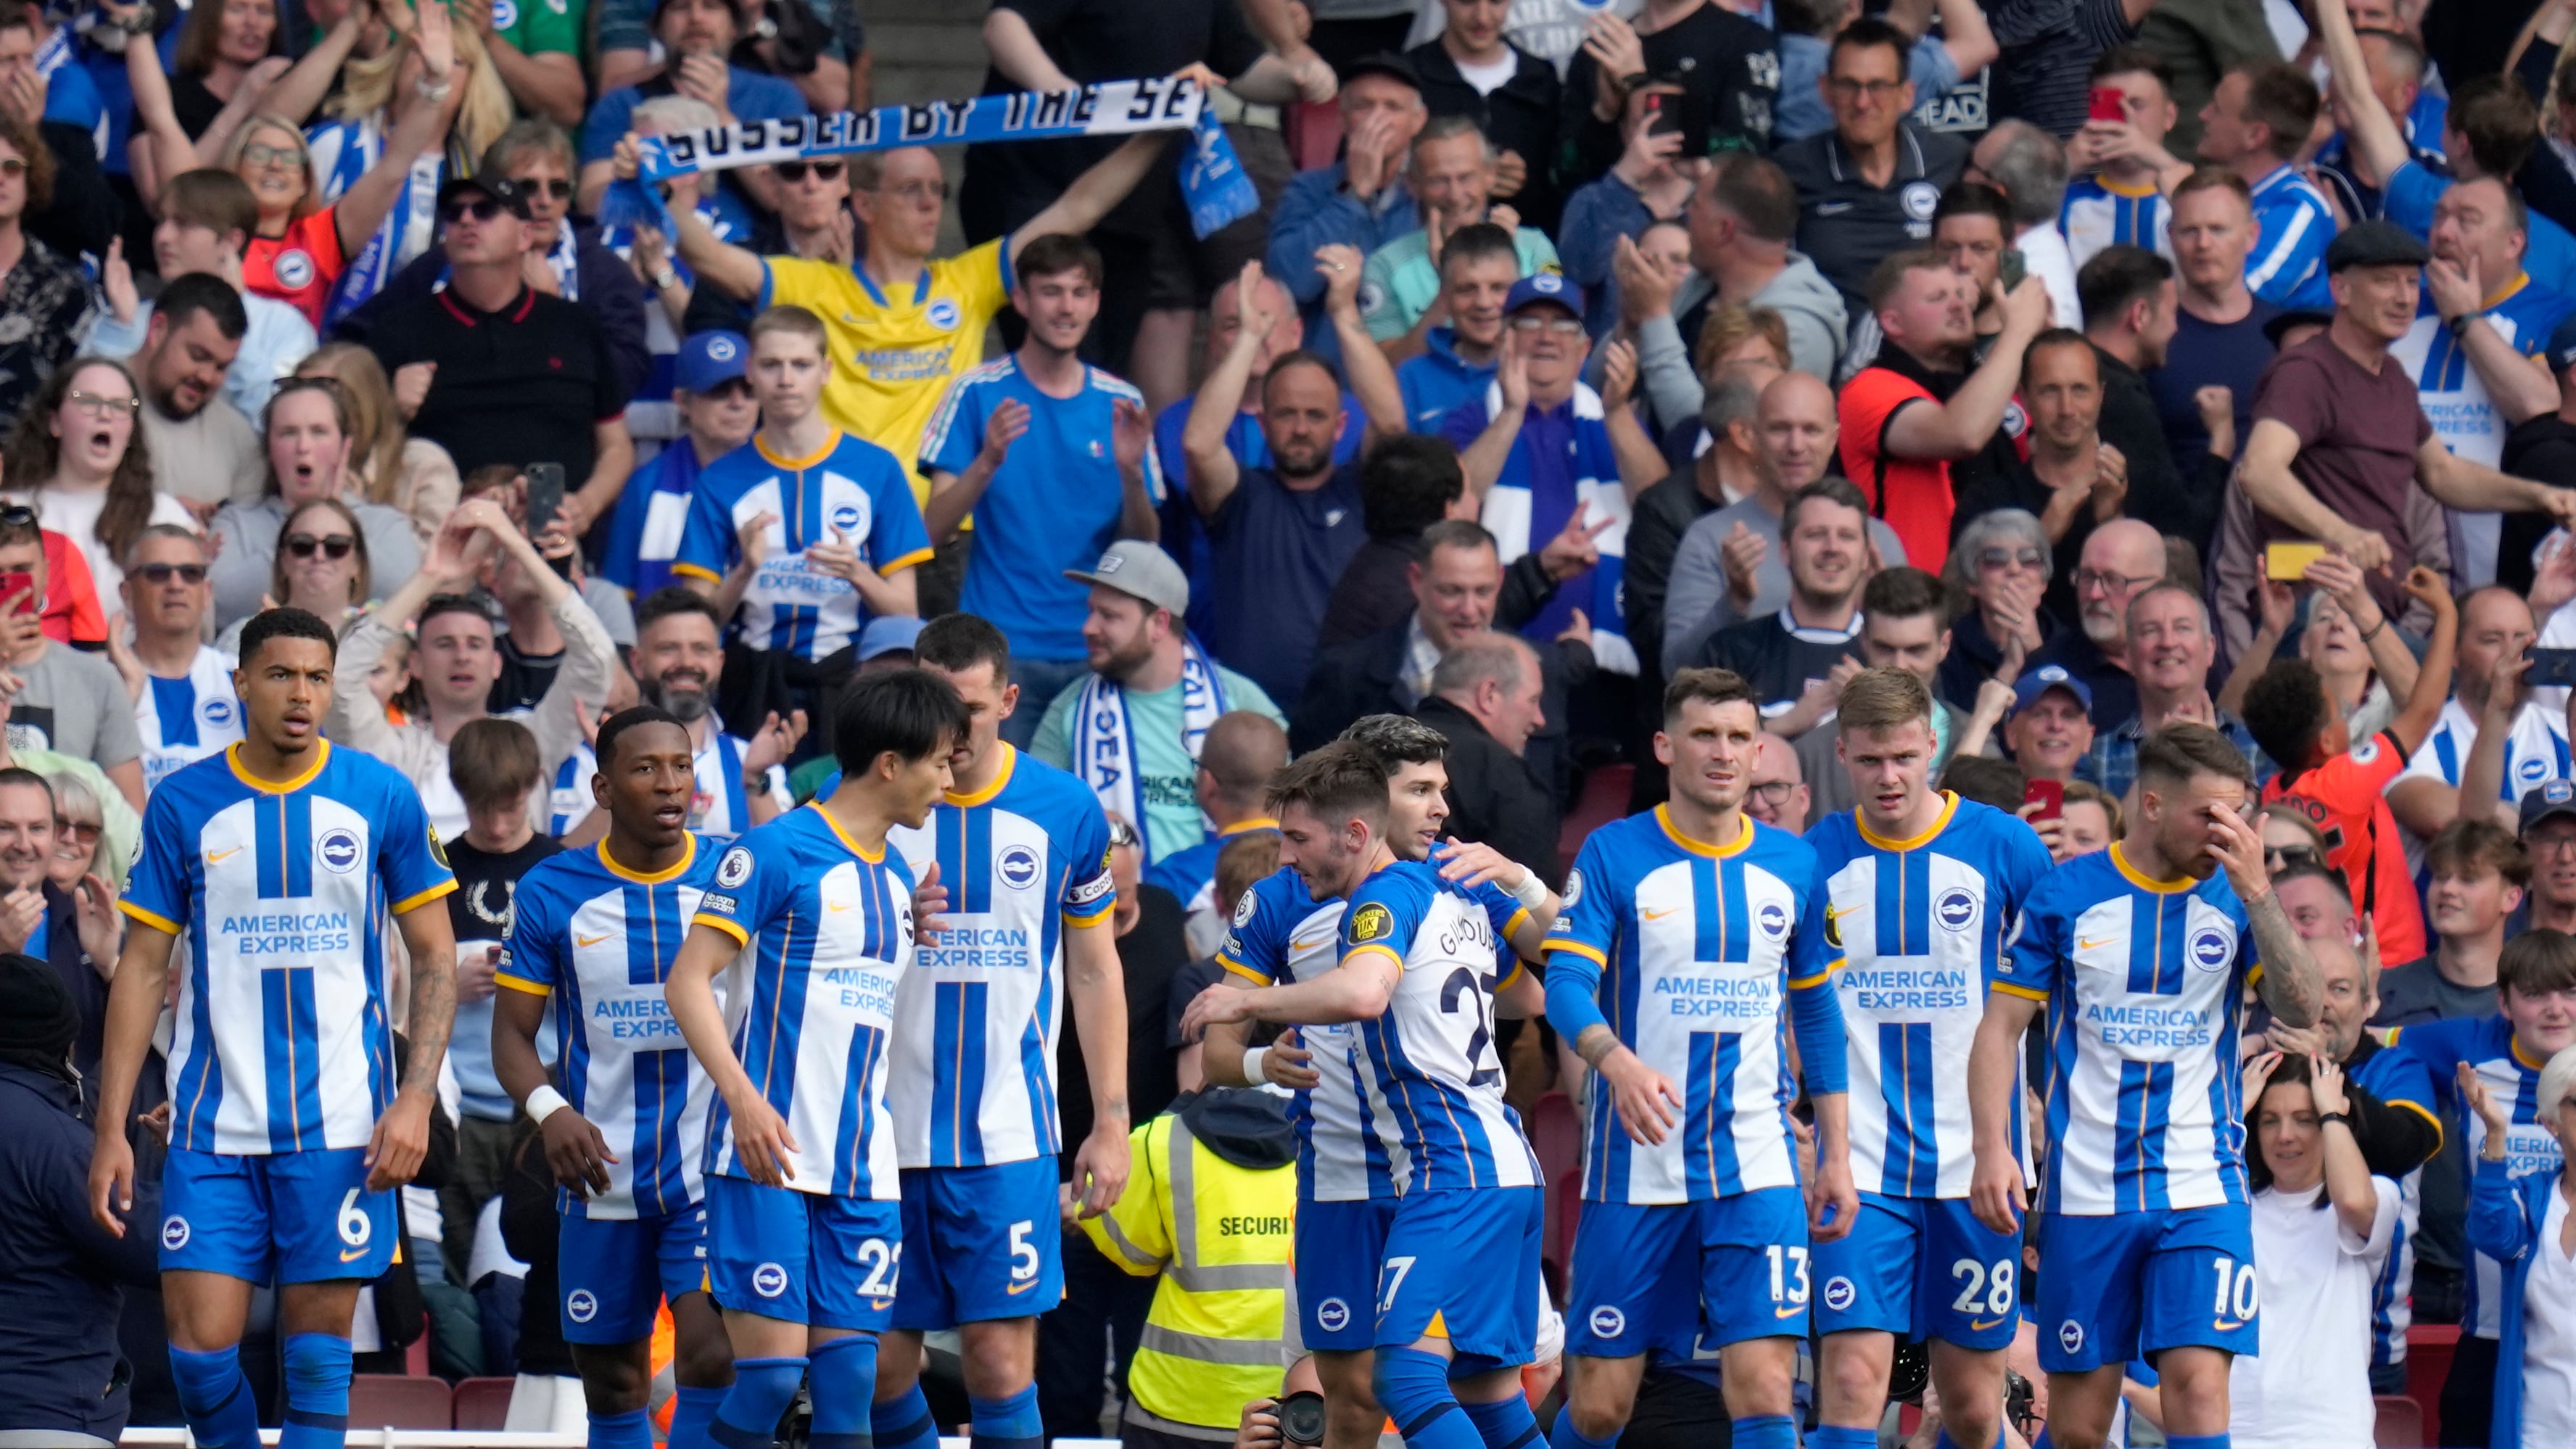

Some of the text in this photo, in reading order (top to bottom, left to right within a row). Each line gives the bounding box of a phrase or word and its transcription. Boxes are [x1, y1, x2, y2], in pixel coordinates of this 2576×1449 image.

[901, 97, 975, 139] BY
[1128, 76, 1189, 120] SE
[221, 913, 348, 934] AMERICAN
[239, 933, 349, 954] EXPRESS
[934, 929, 1027, 946] ERICAN
[917, 949, 1028, 967] EXPRESS
[824, 967, 896, 999] AMERIC
[1654, 977, 1770, 997] AMERICAN
[1841, 970, 1966, 988] AMERICAN
[595, 999, 668, 1017] AMER
[1670, 998, 1774, 1017] EXPRESS
[1858, 990, 1968, 1009] EXPRESS
[2087, 1004, 2210, 1025] AMERICAN
[613, 1019, 680, 1038] EXPR
[2102, 1026, 2210, 1047] EXPRESS
[338, 1186, 371, 1245] 6
[1220, 1217, 1288, 1236] SECURI
[1010, 1220, 1039, 1279] 5
[1766, 1244, 1811, 1303] 13
[1952, 1258, 2013, 1315] 28
[2213, 1257, 2259, 1321] 10
